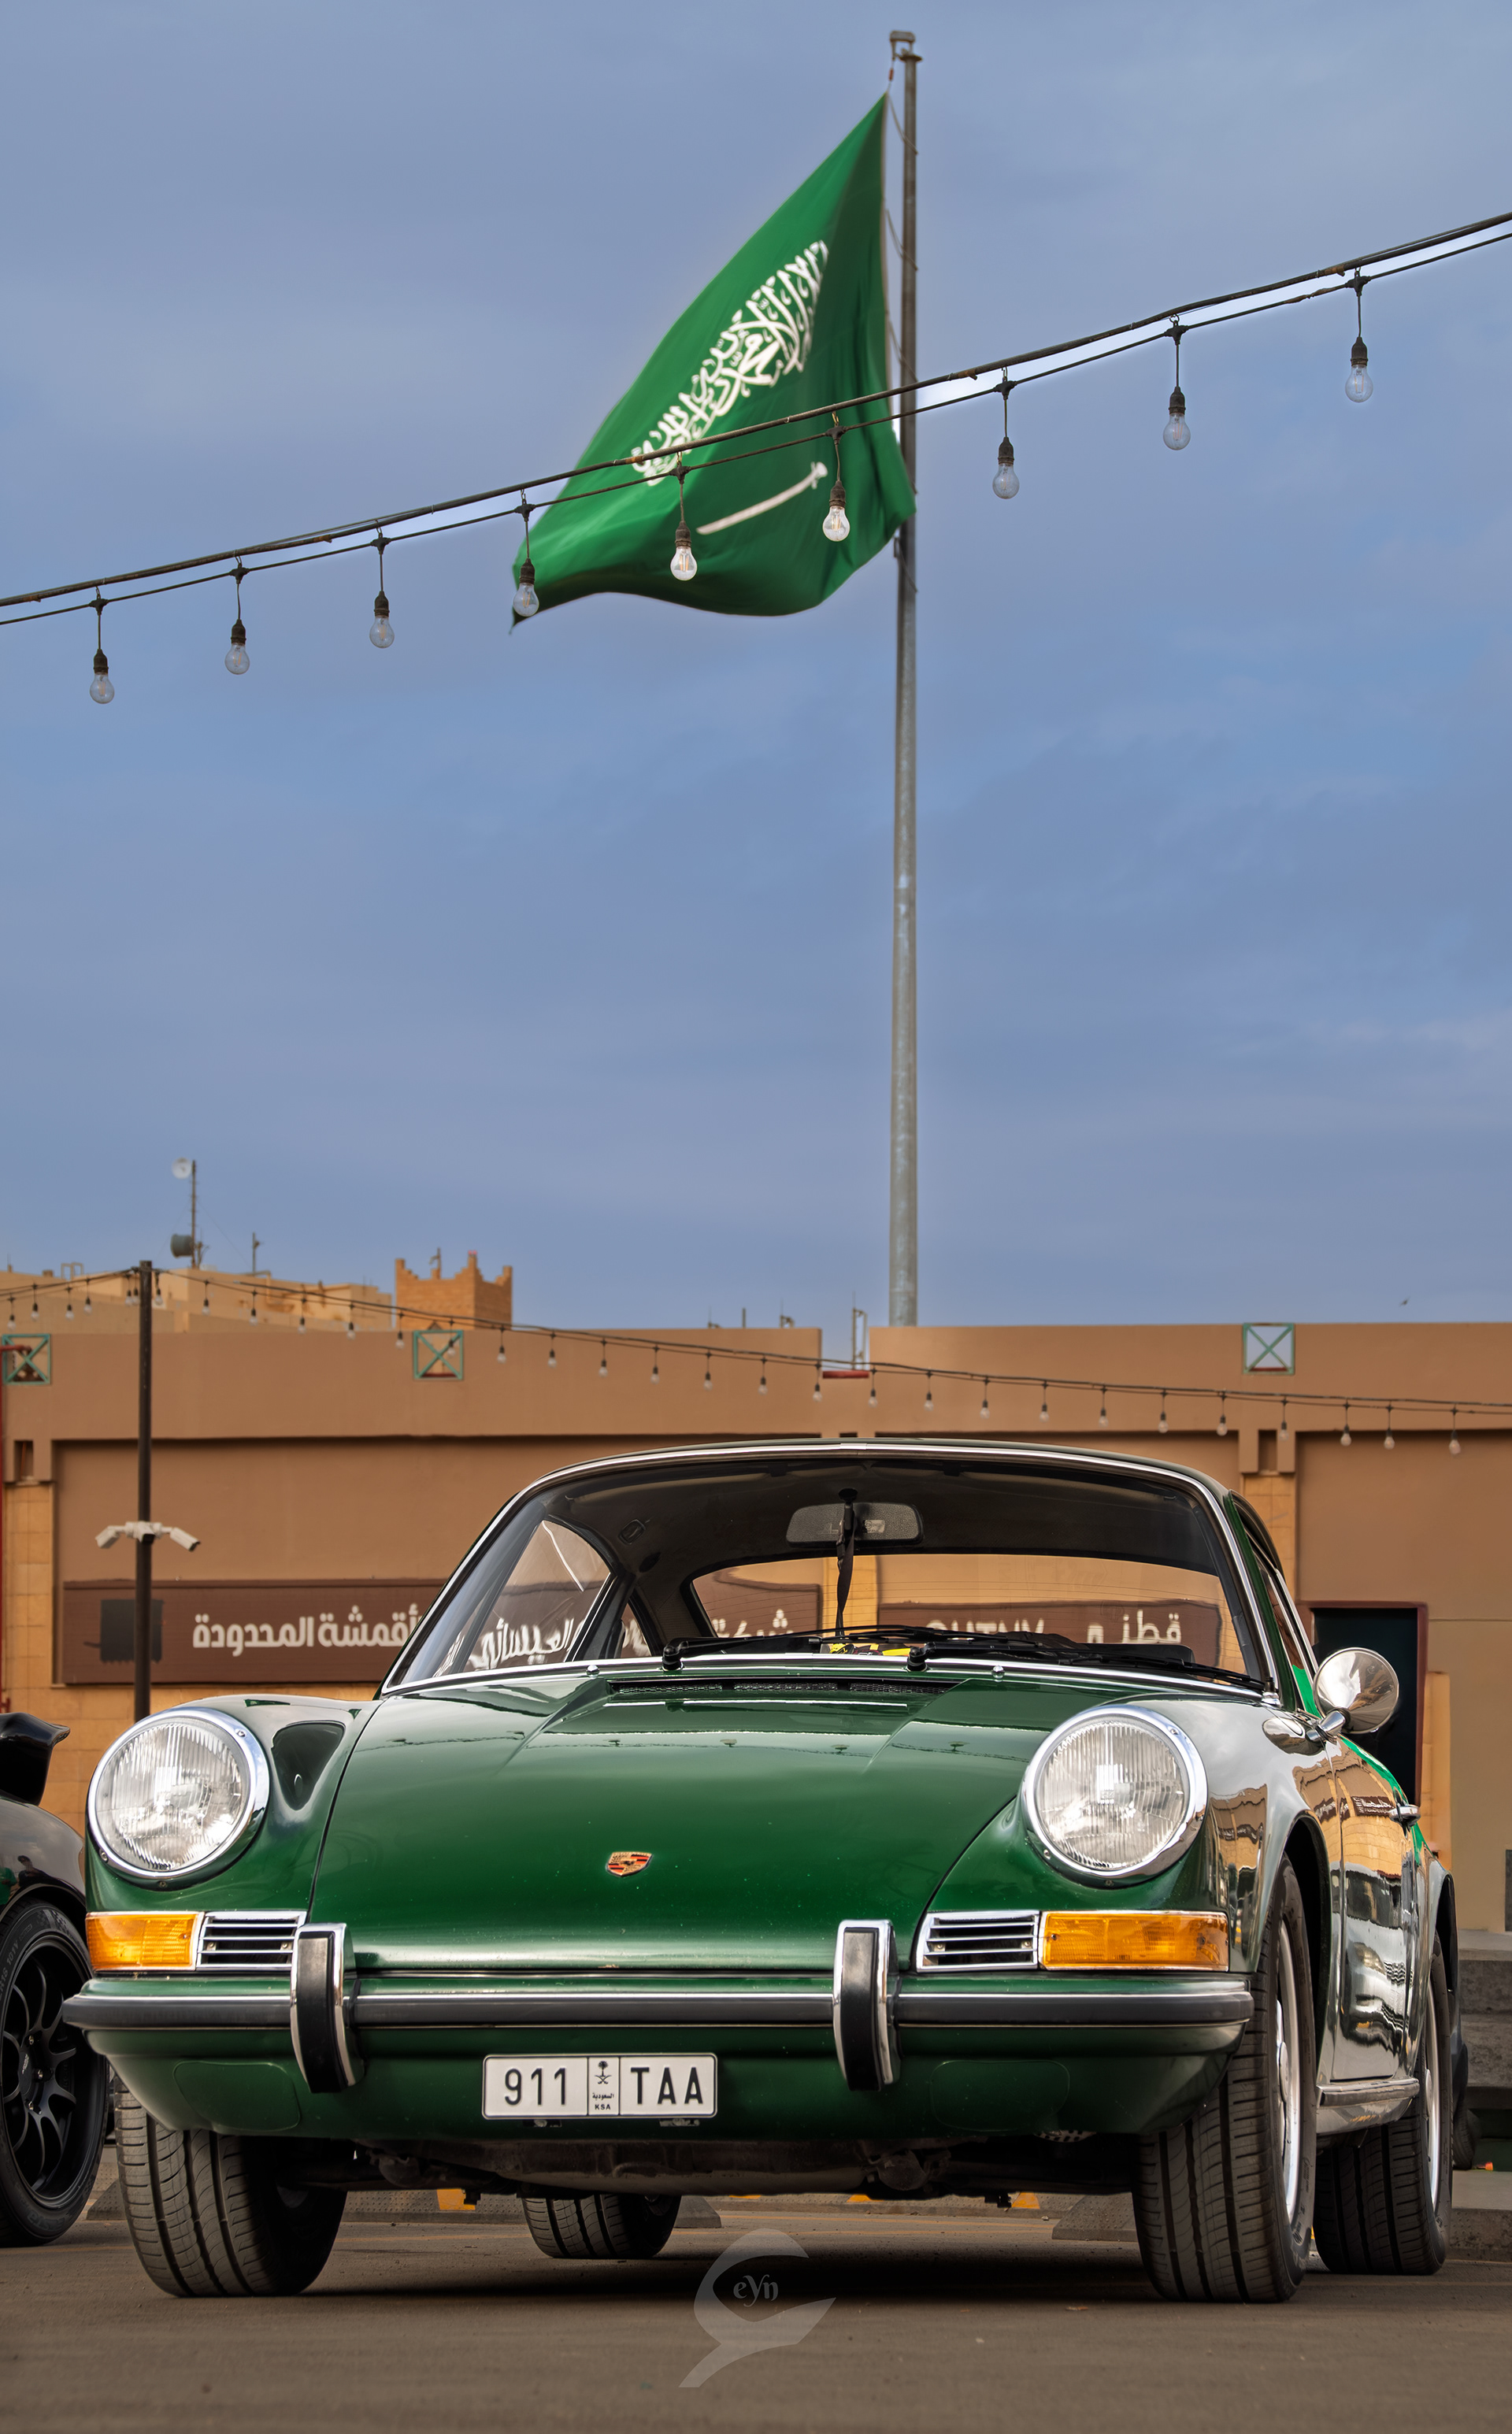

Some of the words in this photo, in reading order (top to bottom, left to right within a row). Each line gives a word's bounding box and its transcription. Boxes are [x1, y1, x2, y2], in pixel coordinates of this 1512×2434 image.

[193, 1613, 314, 1657] المحدودة
[505, 2067, 565, 2106] 911
[630, 2066, 703, 2105] TAA
[592, 2092, 614, 2101] السعودية
